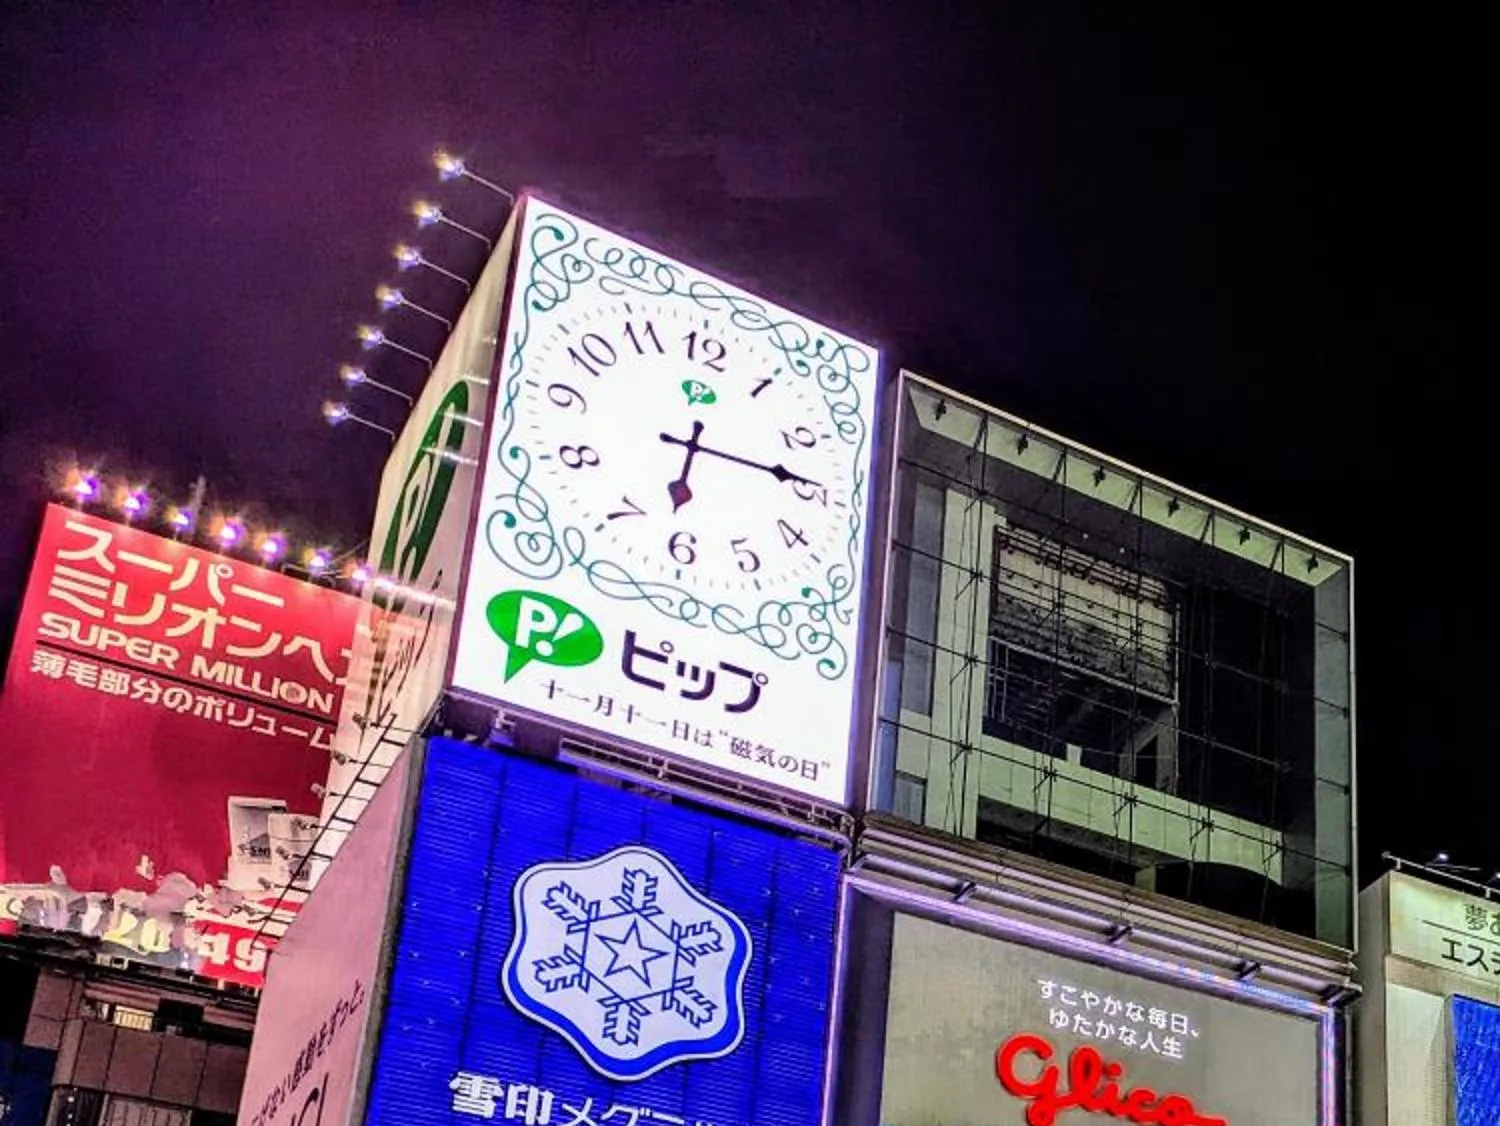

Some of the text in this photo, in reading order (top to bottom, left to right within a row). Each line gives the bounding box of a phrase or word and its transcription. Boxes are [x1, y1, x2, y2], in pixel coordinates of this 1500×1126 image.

[567, 332, 618, 378] 10
[622, 320, 665, 356] 11
[682, 329, 728, 373] 12
[547, 382, 588, 415] 9
[749, 376, 774, 399] 1
[782, 426, 817, 450] 2
[559, 444, 600, 470] 8
[607, 495, 648, 523] 7
[792, 477, 832, 508] 3
[667, 531, 697, 565] 6
[776, 518, 810, 549] 4
[57, 519, 284, 607] スーパー
[731, 537, 761, 574] 5
[48, 563, 358, 685] ミリオンヘ
[38, 612, 334, 714] SUPER MILLION
[620, 627, 770, 714] ピップ
[1049, 1008, 1183, 1059] ゆたかな人生
